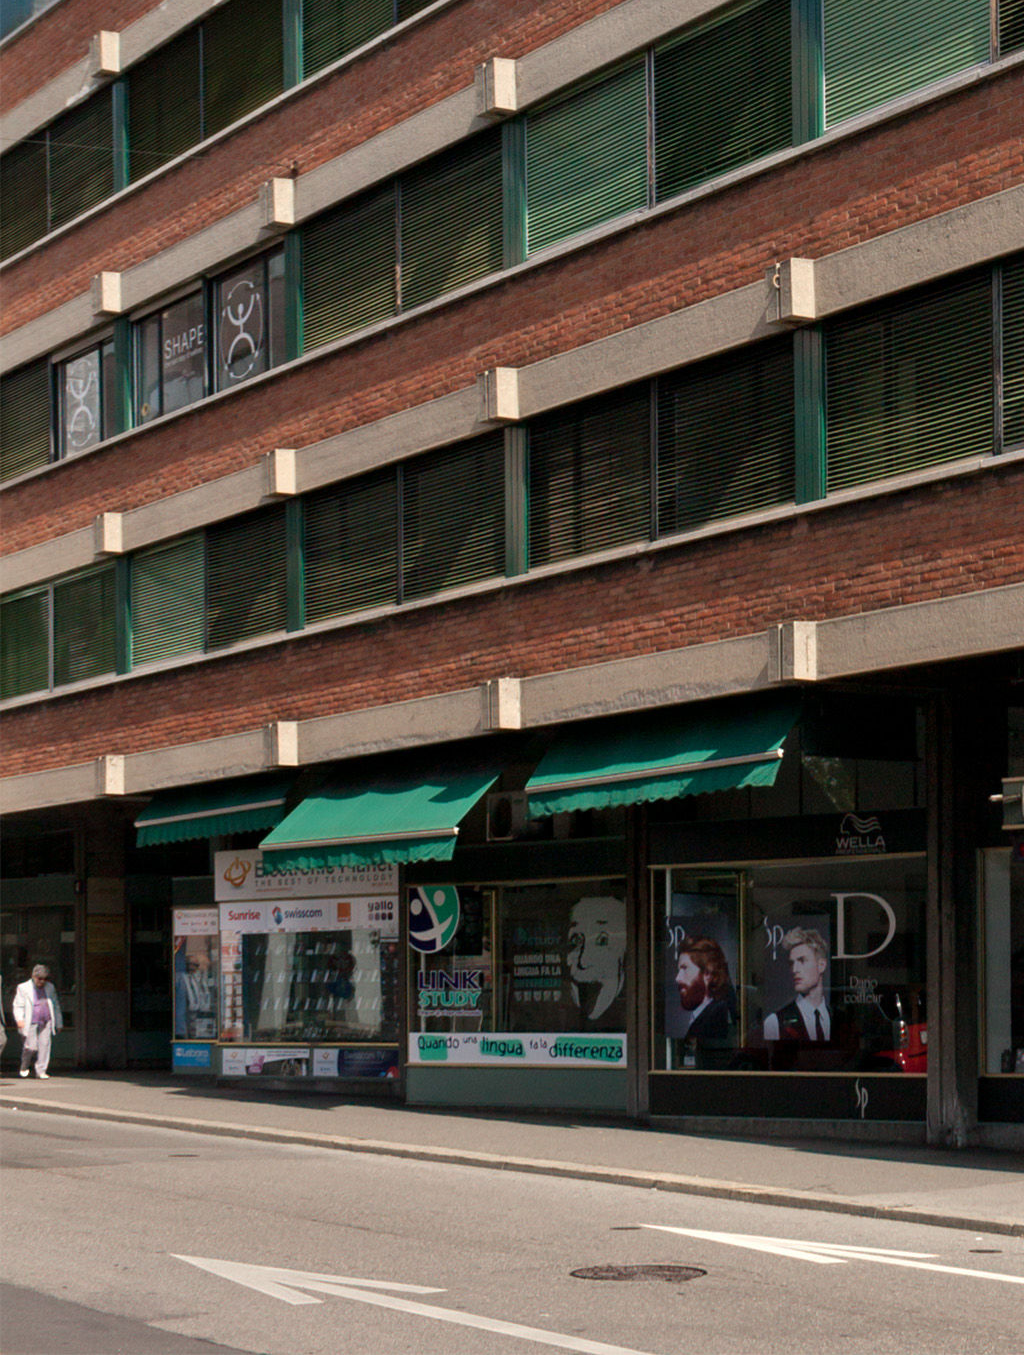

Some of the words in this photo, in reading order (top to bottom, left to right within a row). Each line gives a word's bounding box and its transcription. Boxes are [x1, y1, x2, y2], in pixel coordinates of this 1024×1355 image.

[163, 324, 204, 360] SHAPE
[835, 835, 887, 849] WELLA
[255, 878, 271, 886] THE
[278, 877, 301, 885] BEST
[284, 907, 323, 919] swisscom
[367, 900, 393, 912] yallo
[228, 909, 261, 921] Sunrise
[831, 892, 897, 960] D
[417, 970, 482, 990] LINK
[418, 990, 482, 1008] STUDY
[417, 1035, 460, 1050] Quando
[463, 1036, 478, 1045] una
[481, 1035, 523, 1056] lingua
[549, 1038, 624, 1059] differenza
